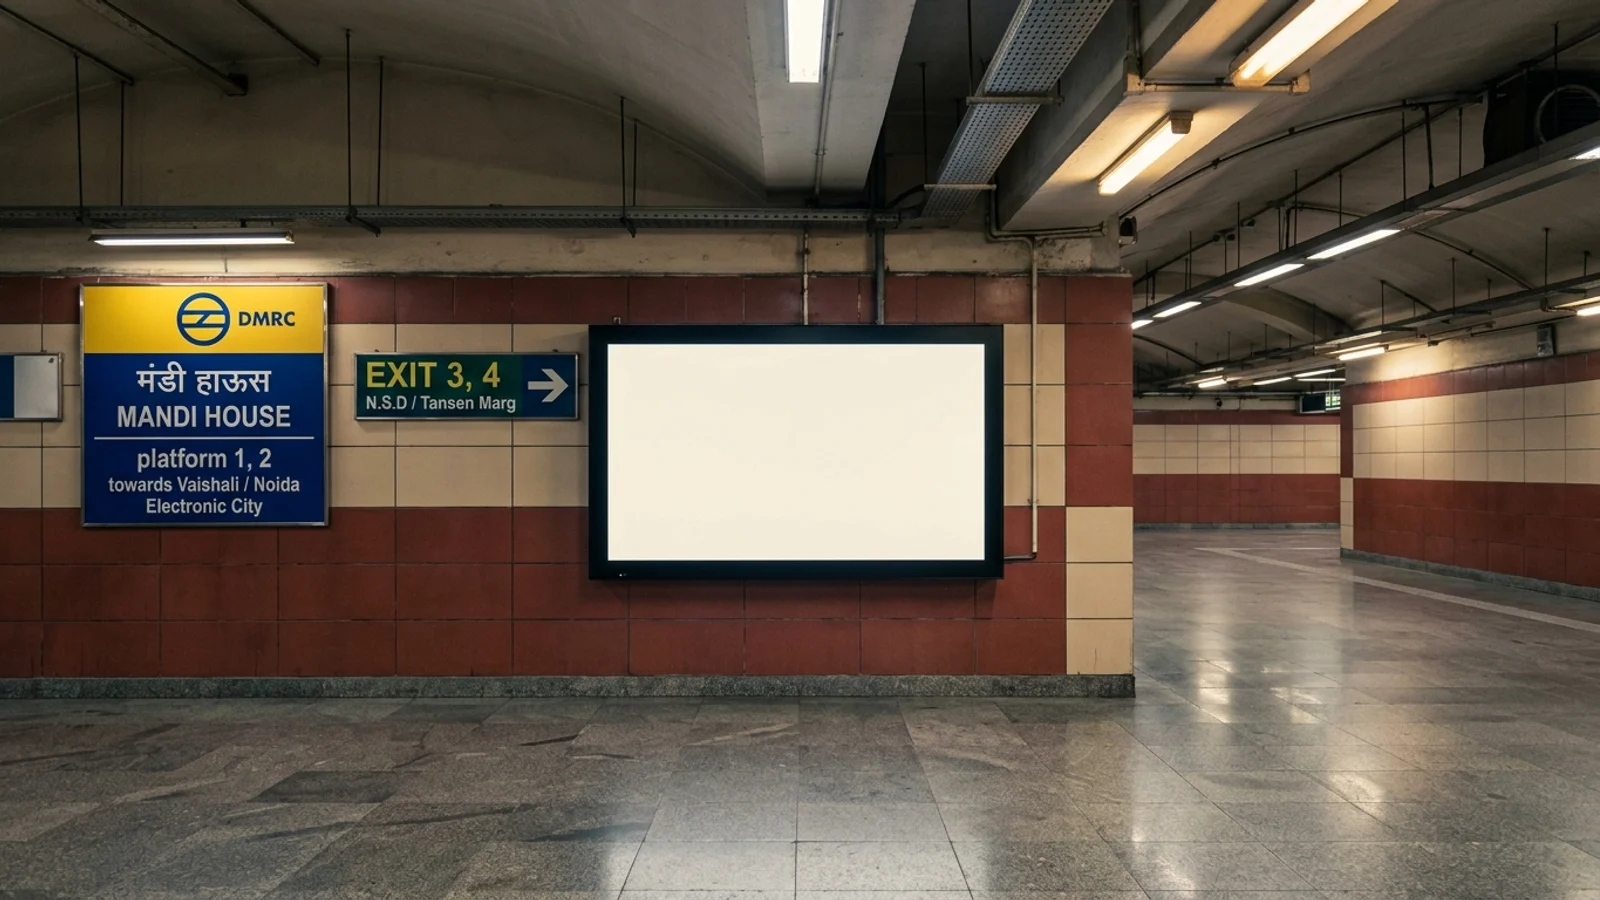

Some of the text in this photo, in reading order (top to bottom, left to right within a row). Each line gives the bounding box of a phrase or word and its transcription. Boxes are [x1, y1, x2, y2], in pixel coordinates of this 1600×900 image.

[238, 311, 296, 327] DMRC
[136, 361, 272, 396] मंडी हाऊस
[366, 361, 501, 393] EXIT 3, 4
[366, 395, 516, 413] N.S.D / Tansen Marg
[117, 405, 291, 428] MANDI HOUSE
[137, 447, 272, 472] platform 1, 2
[108, 476, 300, 492] towards Vaishali / Noida
[146, 498, 263, 517] Electronic City
